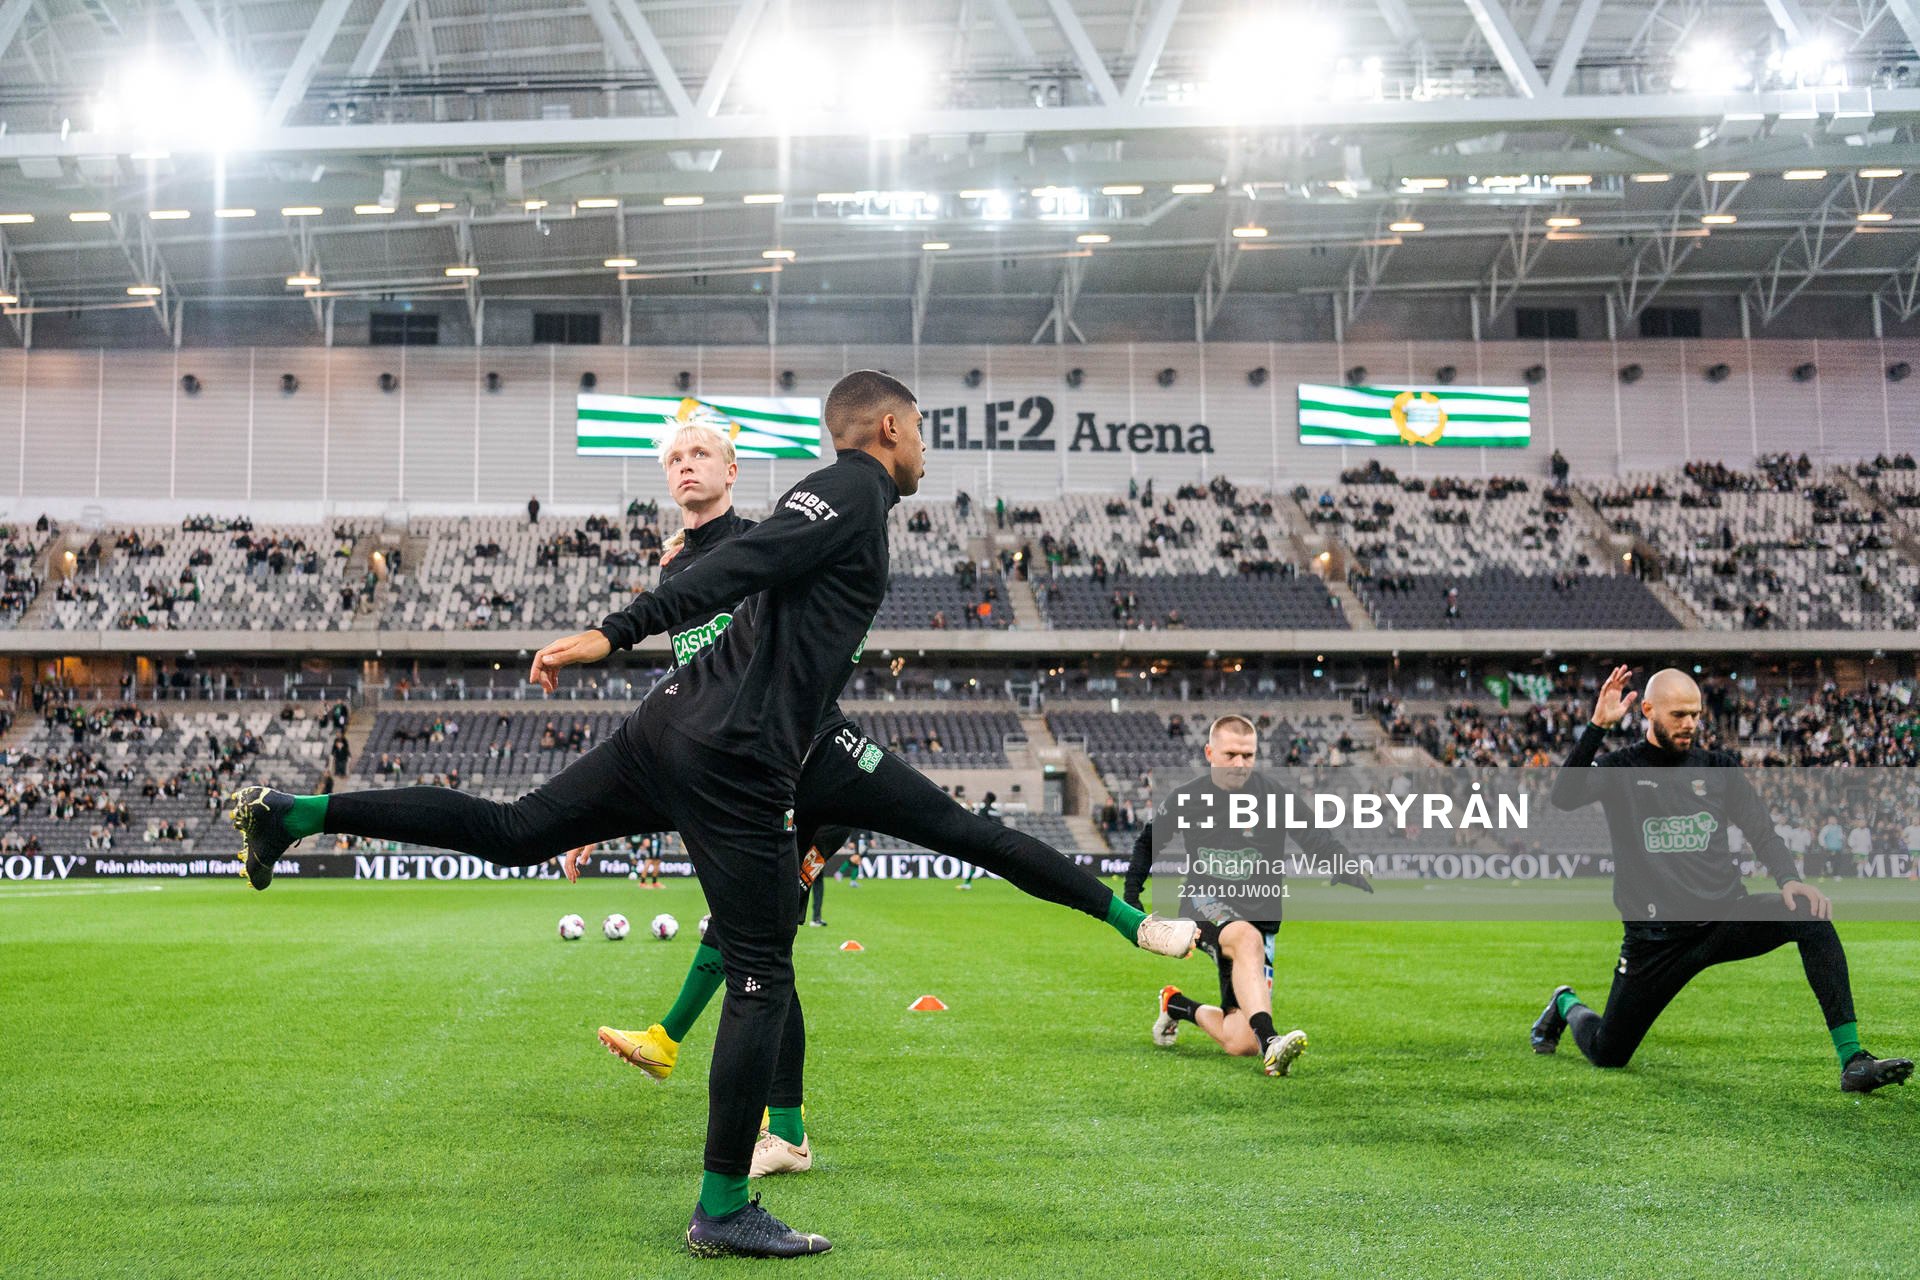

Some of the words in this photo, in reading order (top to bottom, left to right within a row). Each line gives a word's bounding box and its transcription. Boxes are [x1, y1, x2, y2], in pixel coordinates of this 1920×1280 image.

[1069, 412, 1214, 454] Arena
[674, 630, 713, 658] CASH
[834, 728, 858, 752] 22
[1646, 819, 1694, 834] CASH
[1648, 833, 1707, 849] BUDDY
[0, 855, 78, 881] OLV
[95, 858, 125, 874] Från
[126, 858, 188, 876] råbetong
[189, 858, 207, 874] till
[1647, 902, 1657, 919] 9
